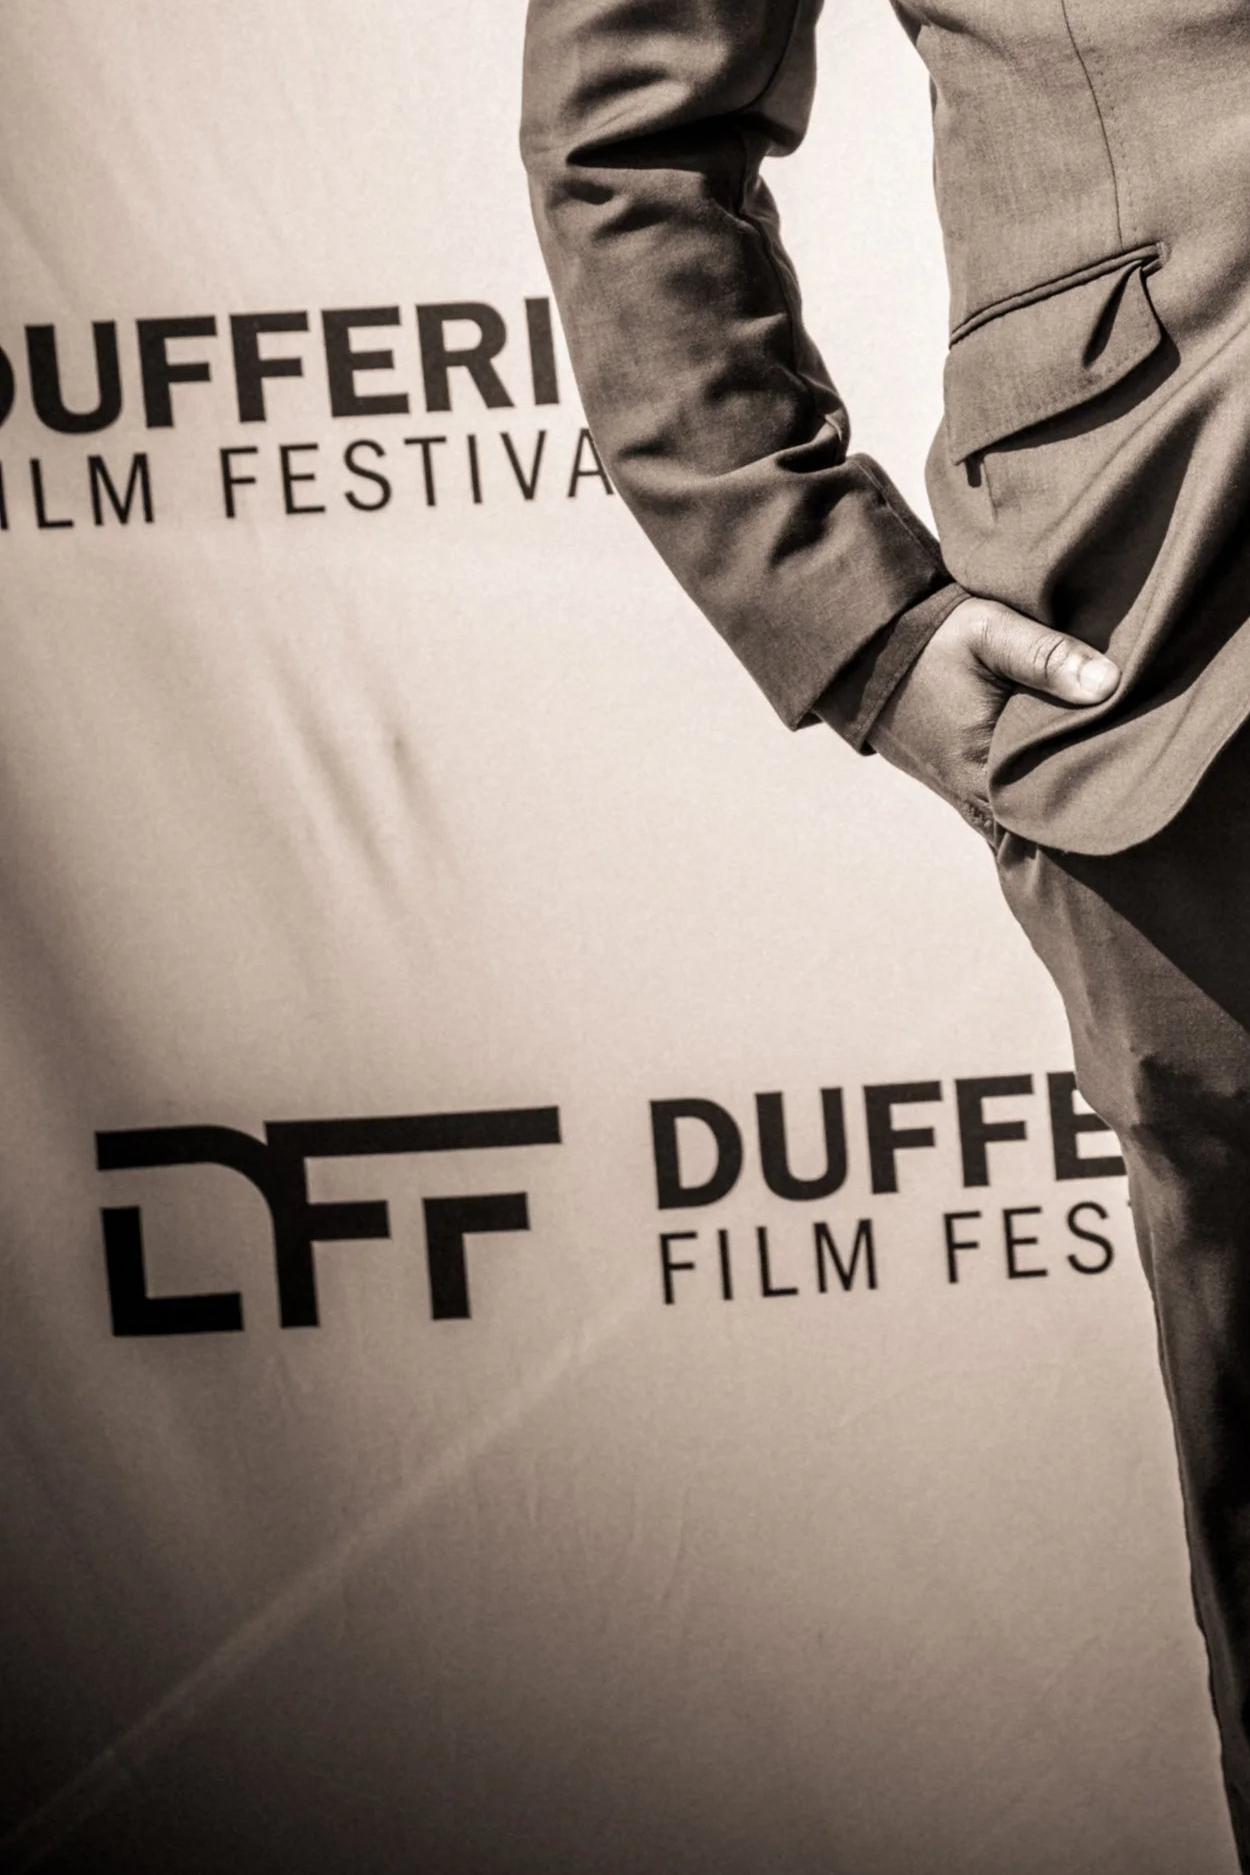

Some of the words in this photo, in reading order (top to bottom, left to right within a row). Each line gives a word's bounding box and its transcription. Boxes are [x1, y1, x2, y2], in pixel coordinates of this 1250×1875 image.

[0, 297, 560, 437] UFFERI
[220, 428, 614, 520] FESTIVA
[650, 1071, 1128, 1211] DUFFE
[93, 1107, 562, 1340] DFF
[659, 1218, 878, 1306] FILM
